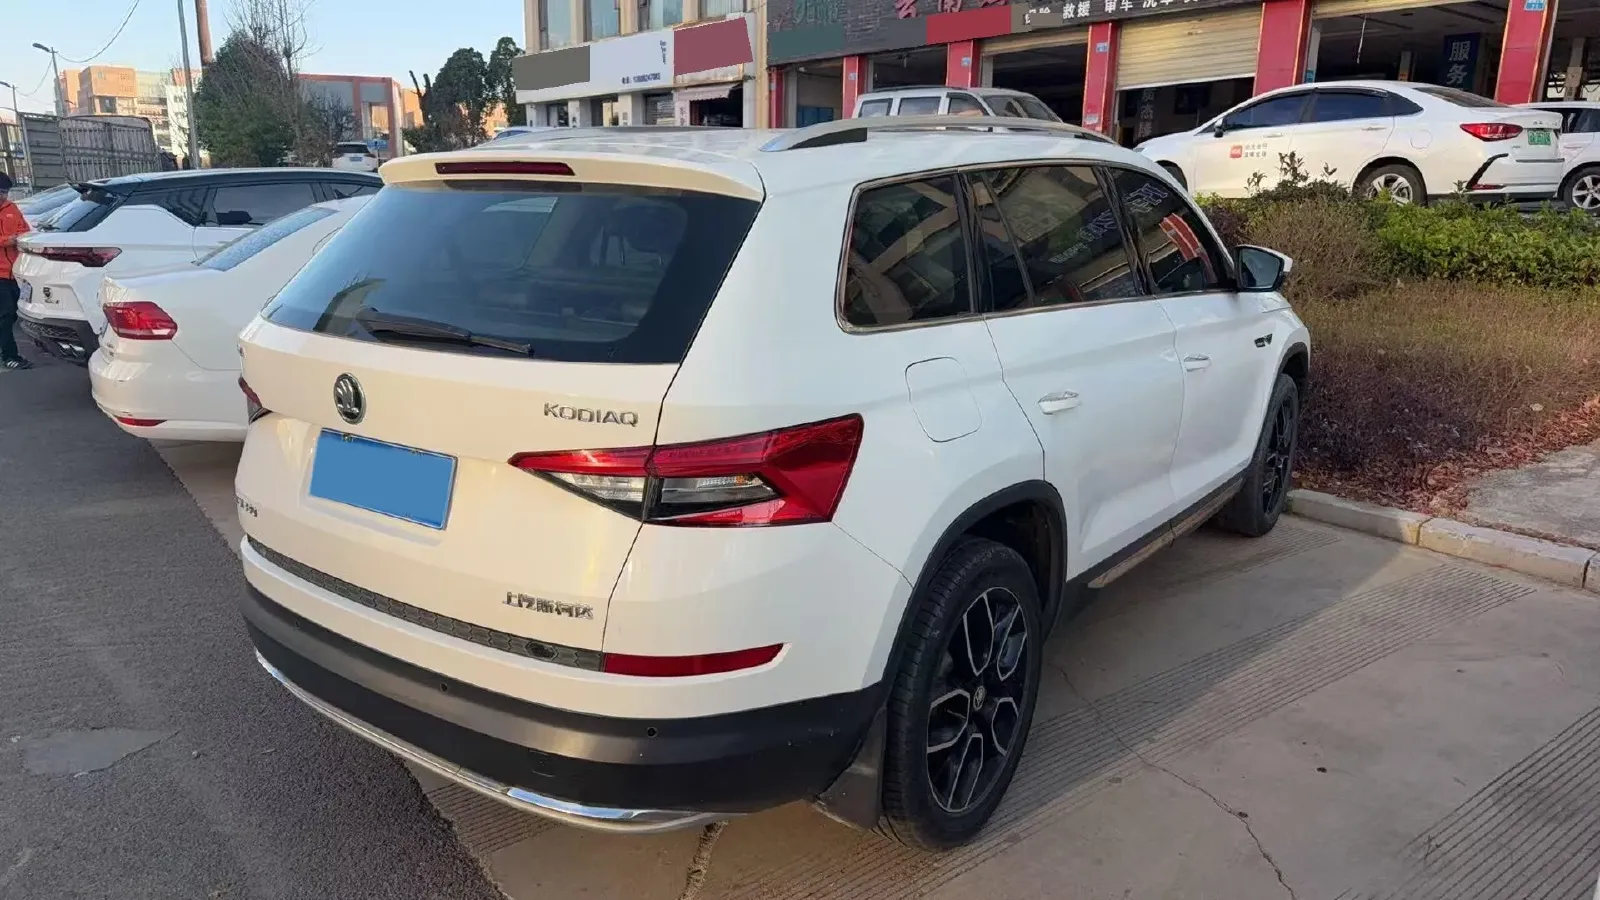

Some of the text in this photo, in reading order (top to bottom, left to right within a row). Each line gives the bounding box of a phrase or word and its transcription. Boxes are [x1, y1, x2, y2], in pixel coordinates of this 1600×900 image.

[1062, 1, 1091, 19] 救援
[1448, 40, 1471, 85] 服务
[543, 402, 639, 427] KODIAQ
[502, 591, 594, 620] 上汽斯柯达
